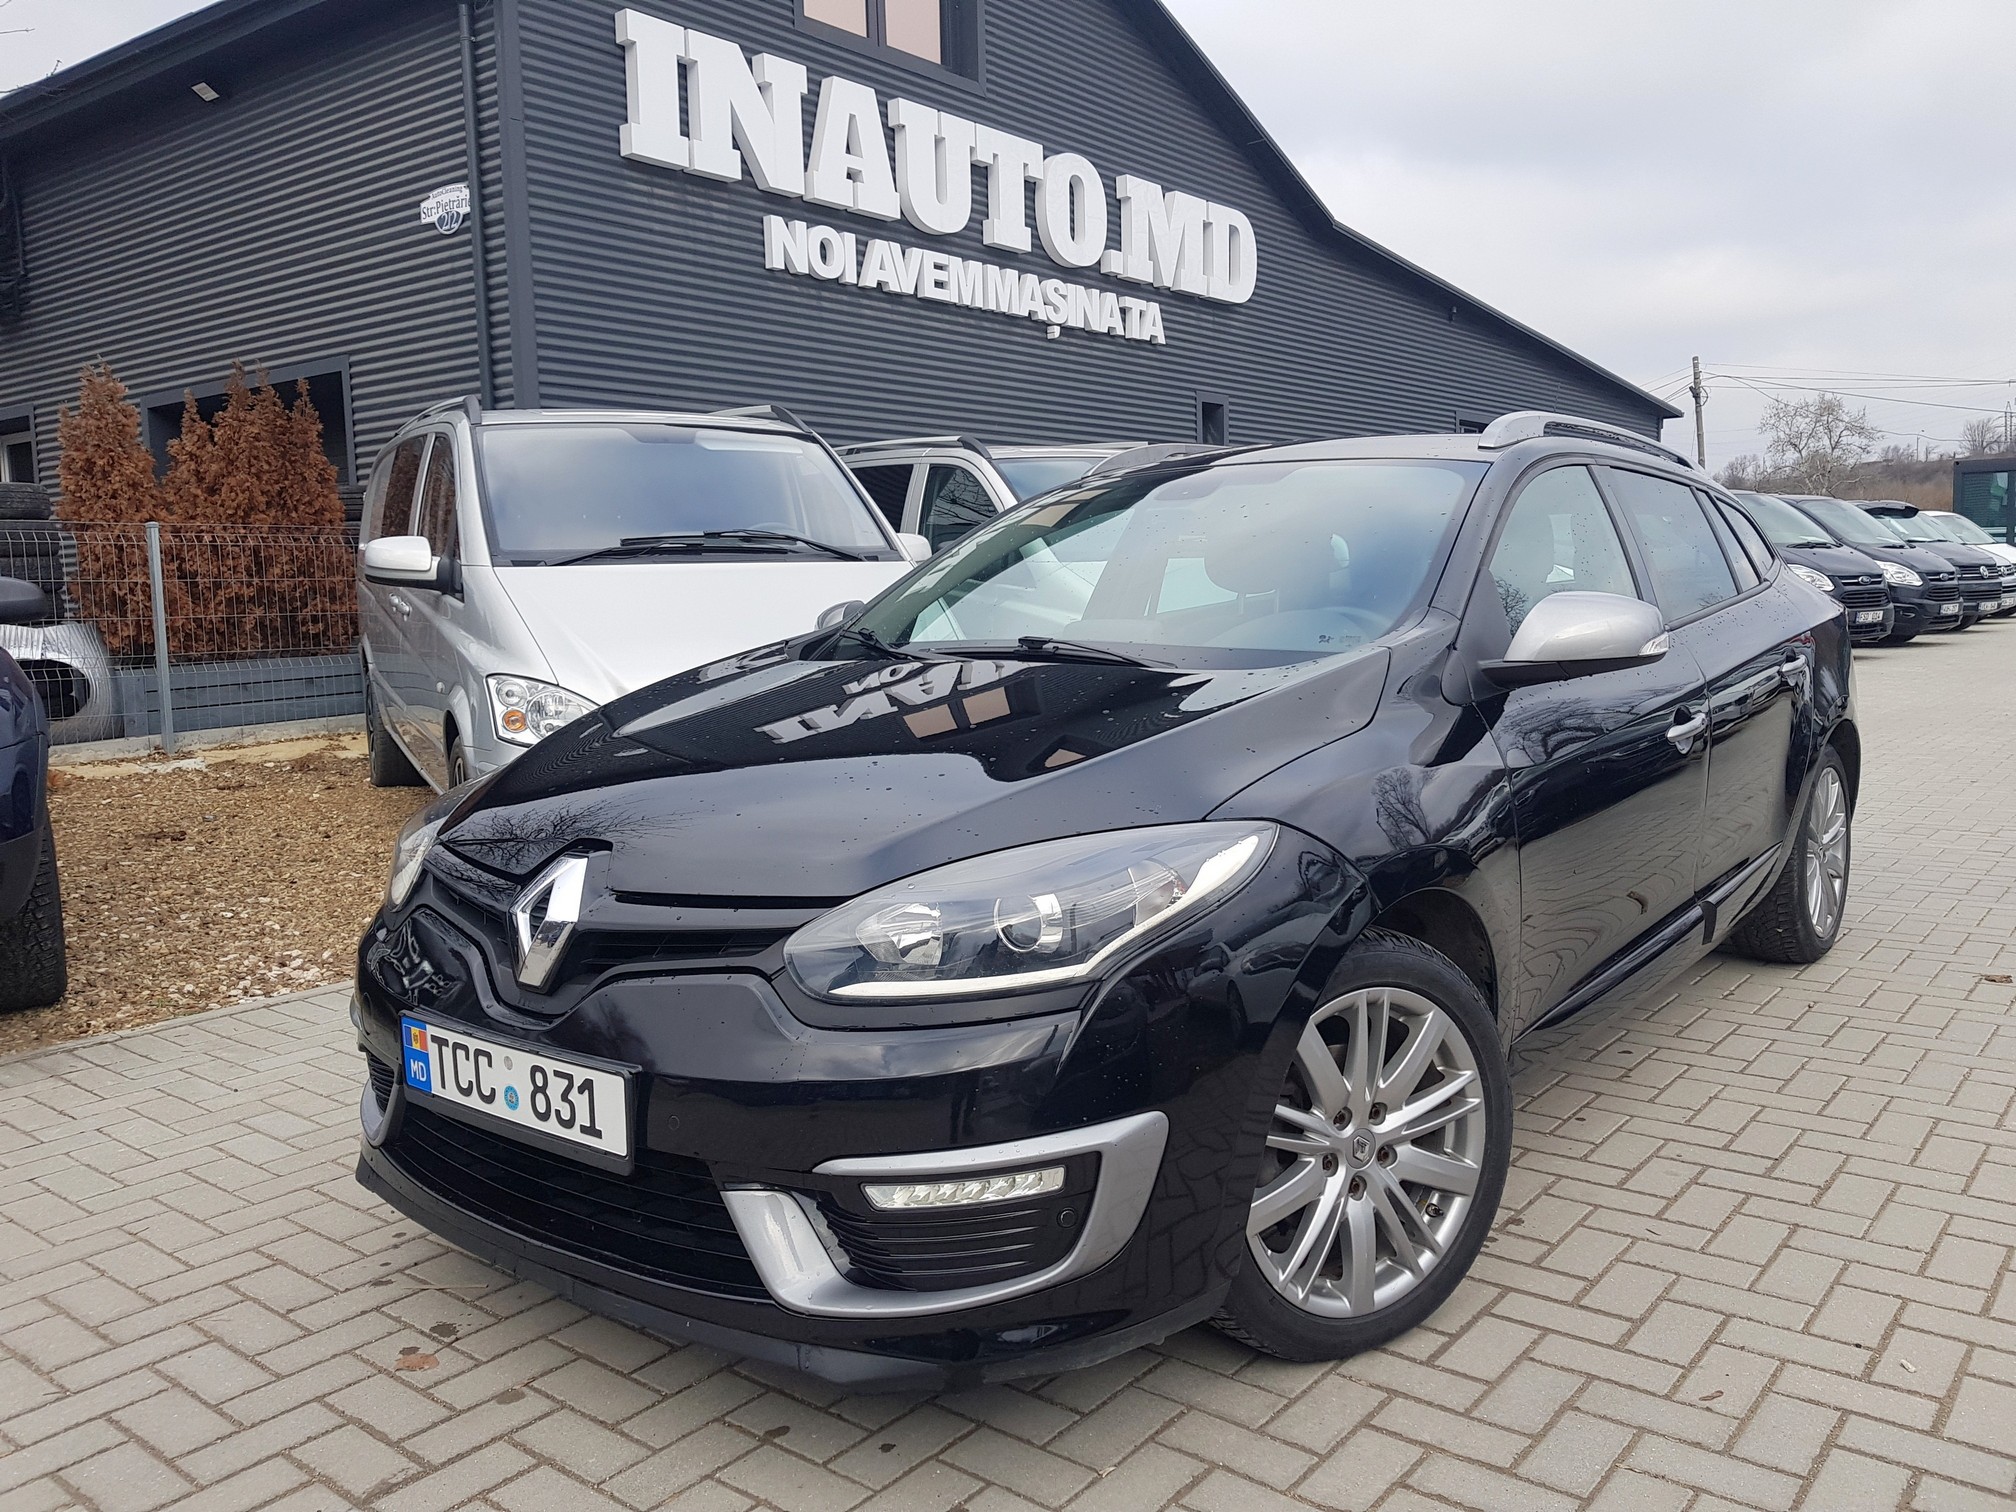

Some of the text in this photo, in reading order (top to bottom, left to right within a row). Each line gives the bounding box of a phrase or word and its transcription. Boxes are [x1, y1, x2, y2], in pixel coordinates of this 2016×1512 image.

[615, 8, 1257, 304] INAUTO.MD
[410, 1058, 426, 1081] MD
[430, 1034, 602, 1140] TCC 831
